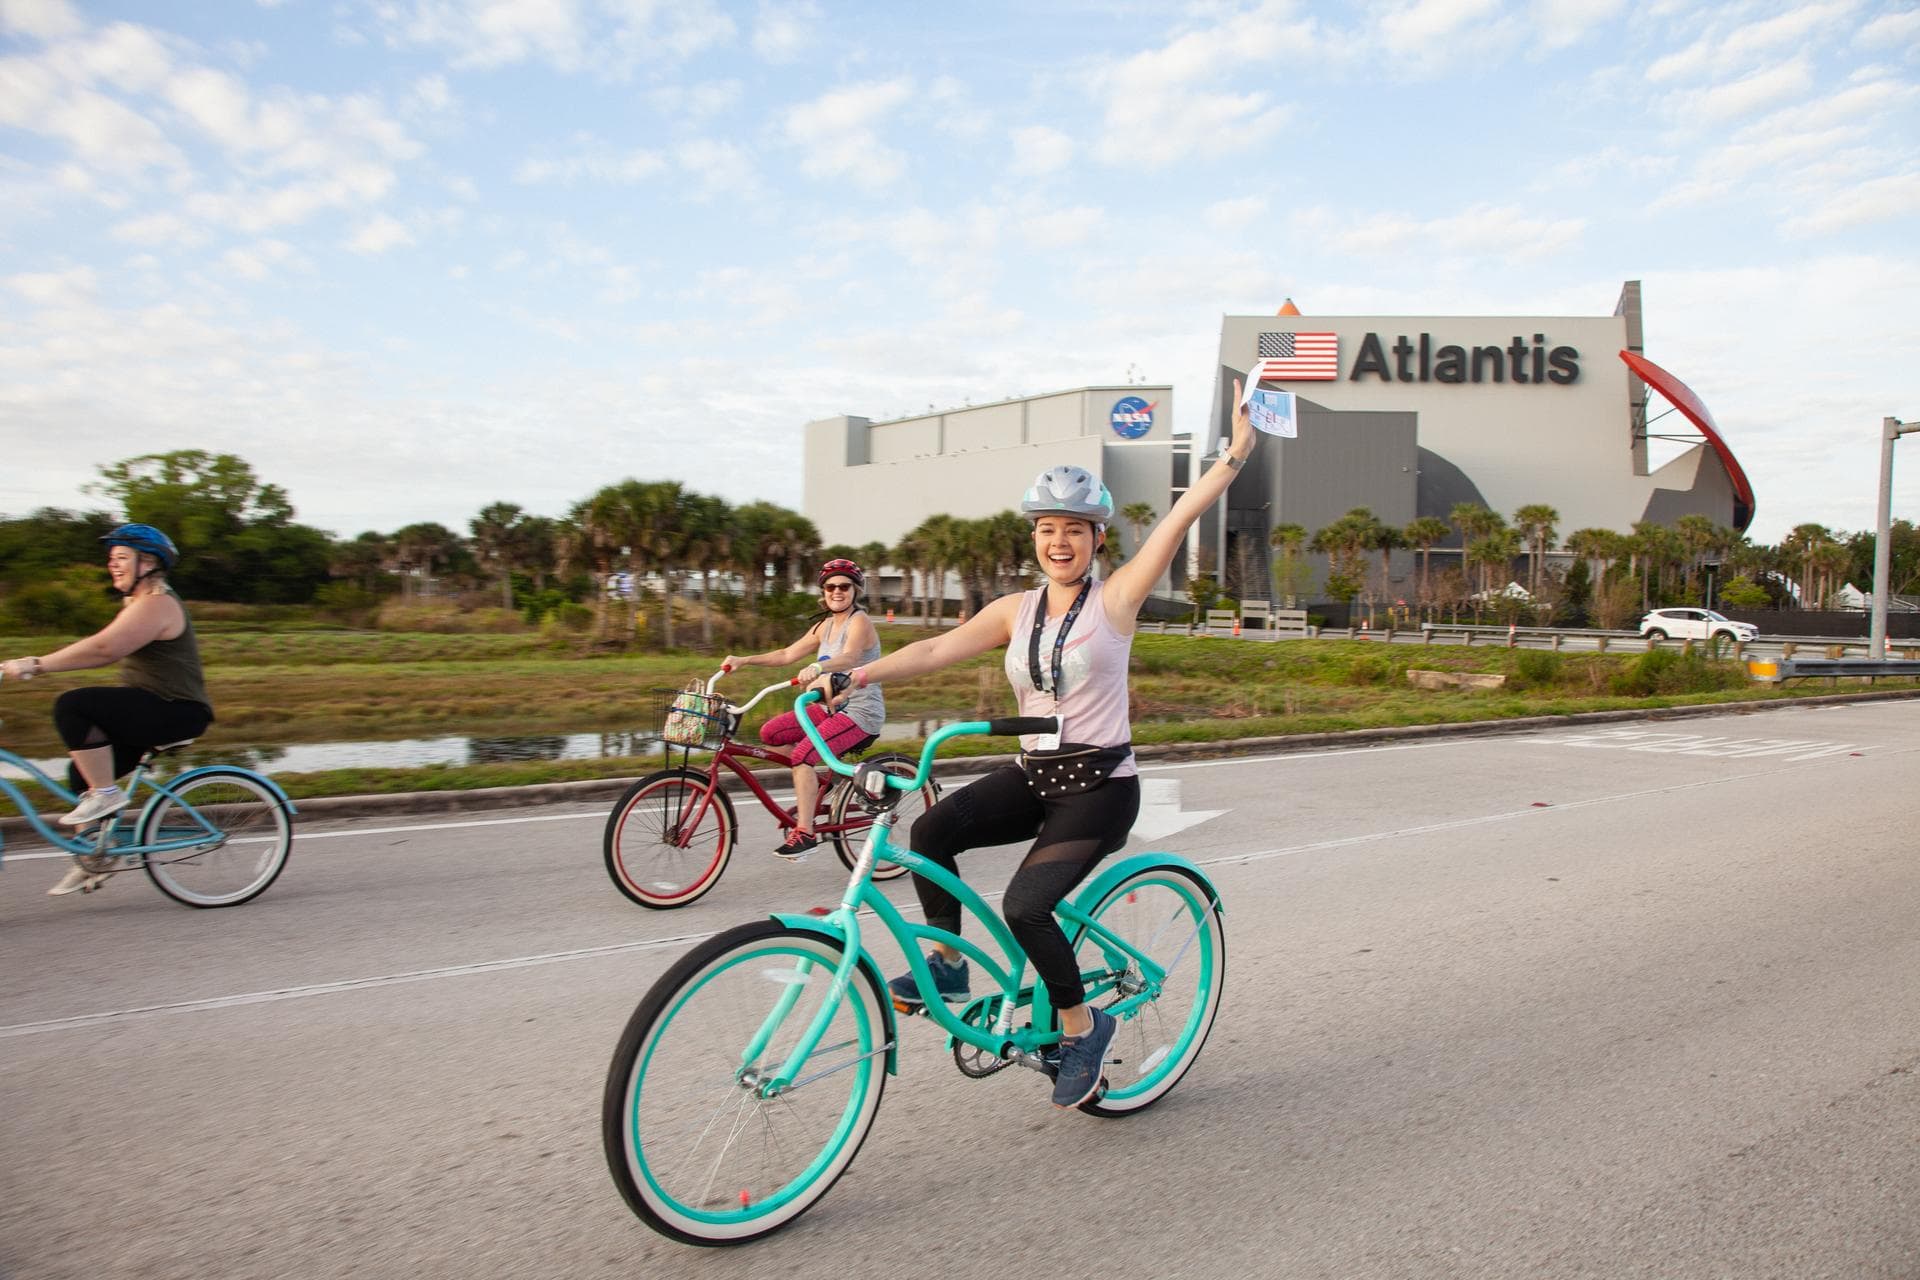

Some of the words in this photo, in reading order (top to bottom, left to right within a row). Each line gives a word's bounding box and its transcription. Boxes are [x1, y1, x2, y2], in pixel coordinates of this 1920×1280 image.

[1349, 332, 1580, 385] Atlantis
[1112, 413, 1152, 423] NASA
[1009, 649, 1087, 674] NA
